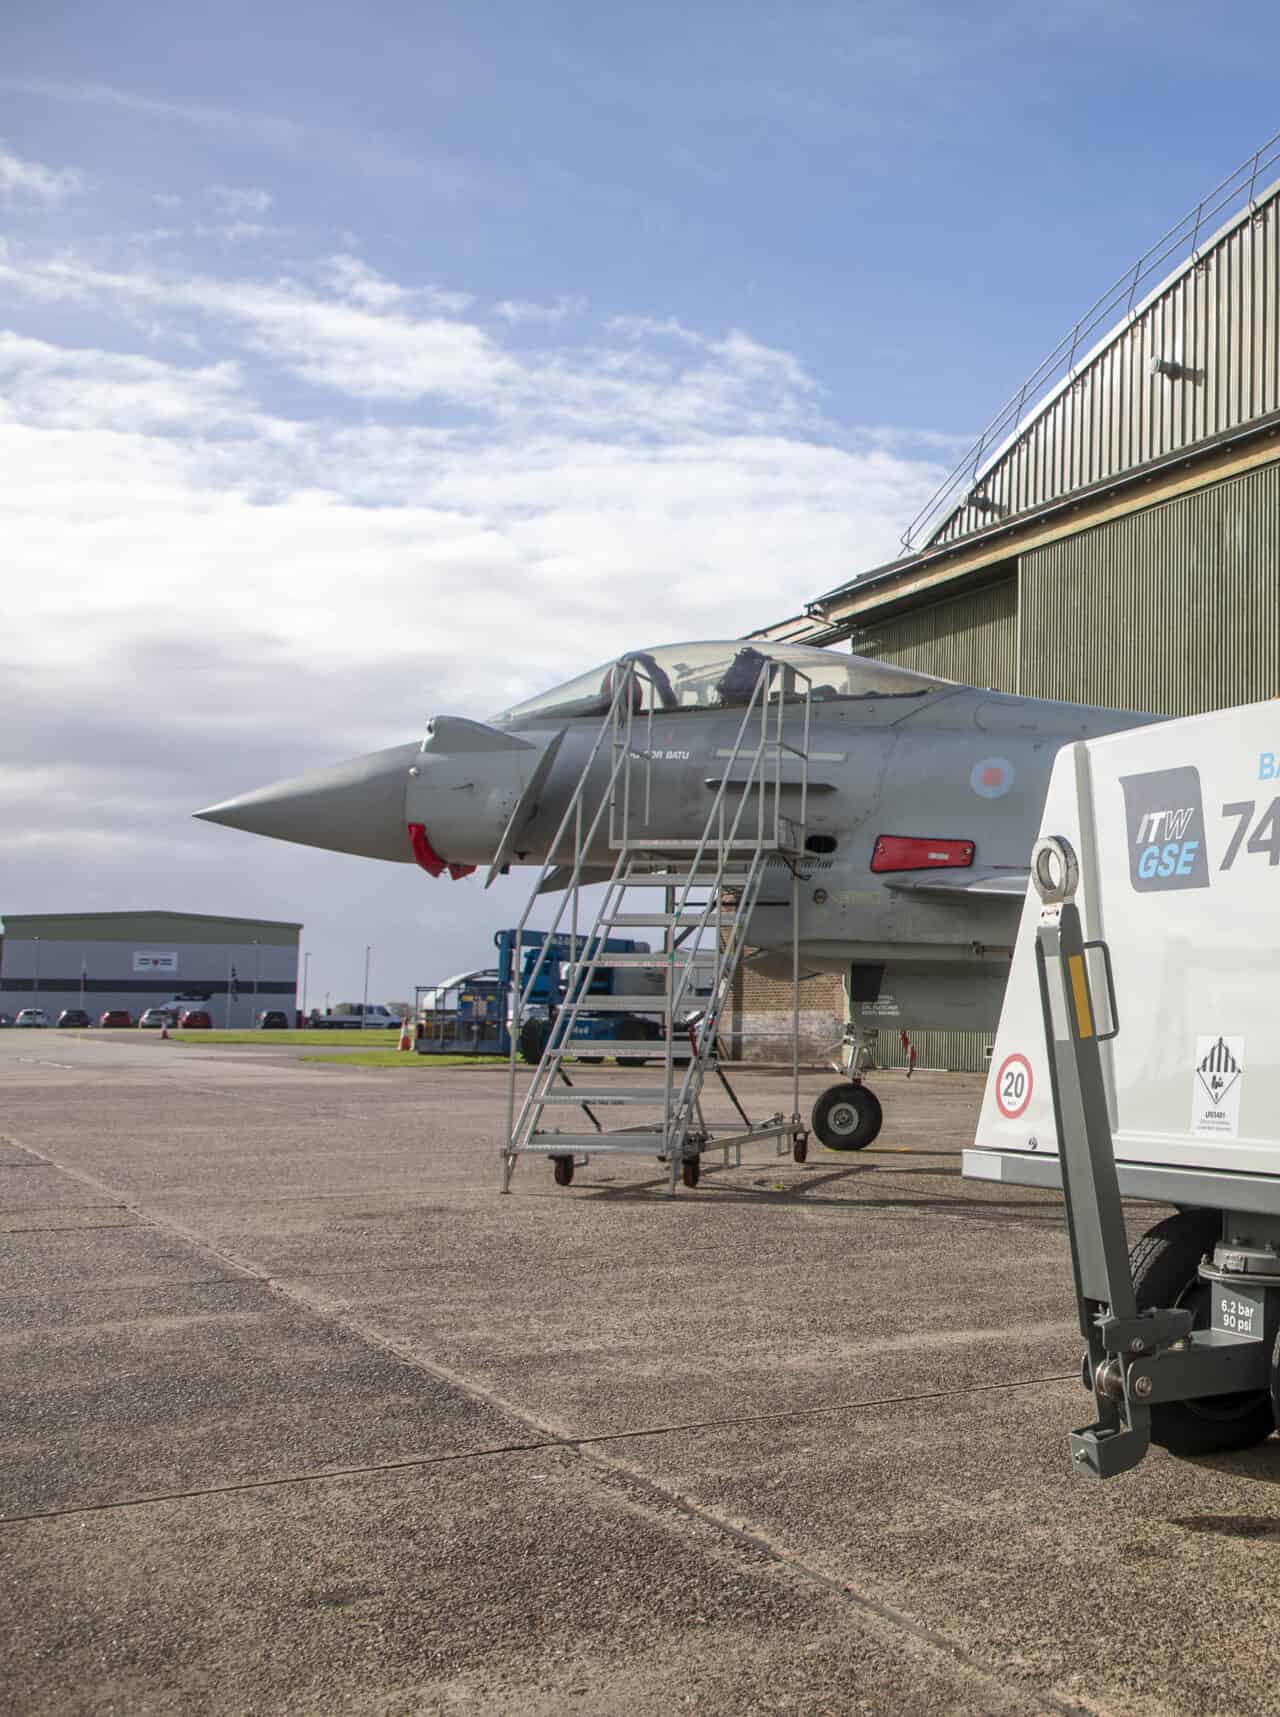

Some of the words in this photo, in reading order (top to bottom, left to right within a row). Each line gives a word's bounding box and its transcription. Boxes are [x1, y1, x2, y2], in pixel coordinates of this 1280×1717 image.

[1136, 807, 1195, 844] ITW
[1136, 840, 1200, 879] GSE
[1003, 1071, 1025, 1098] 20
[1221, 1299, 1236, 1314] 6.2
[1238, 1301, 1254, 1317] bar
[1223, 1313, 1237, 1327] 90
[1238, 1318, 1252, 1332] psi
